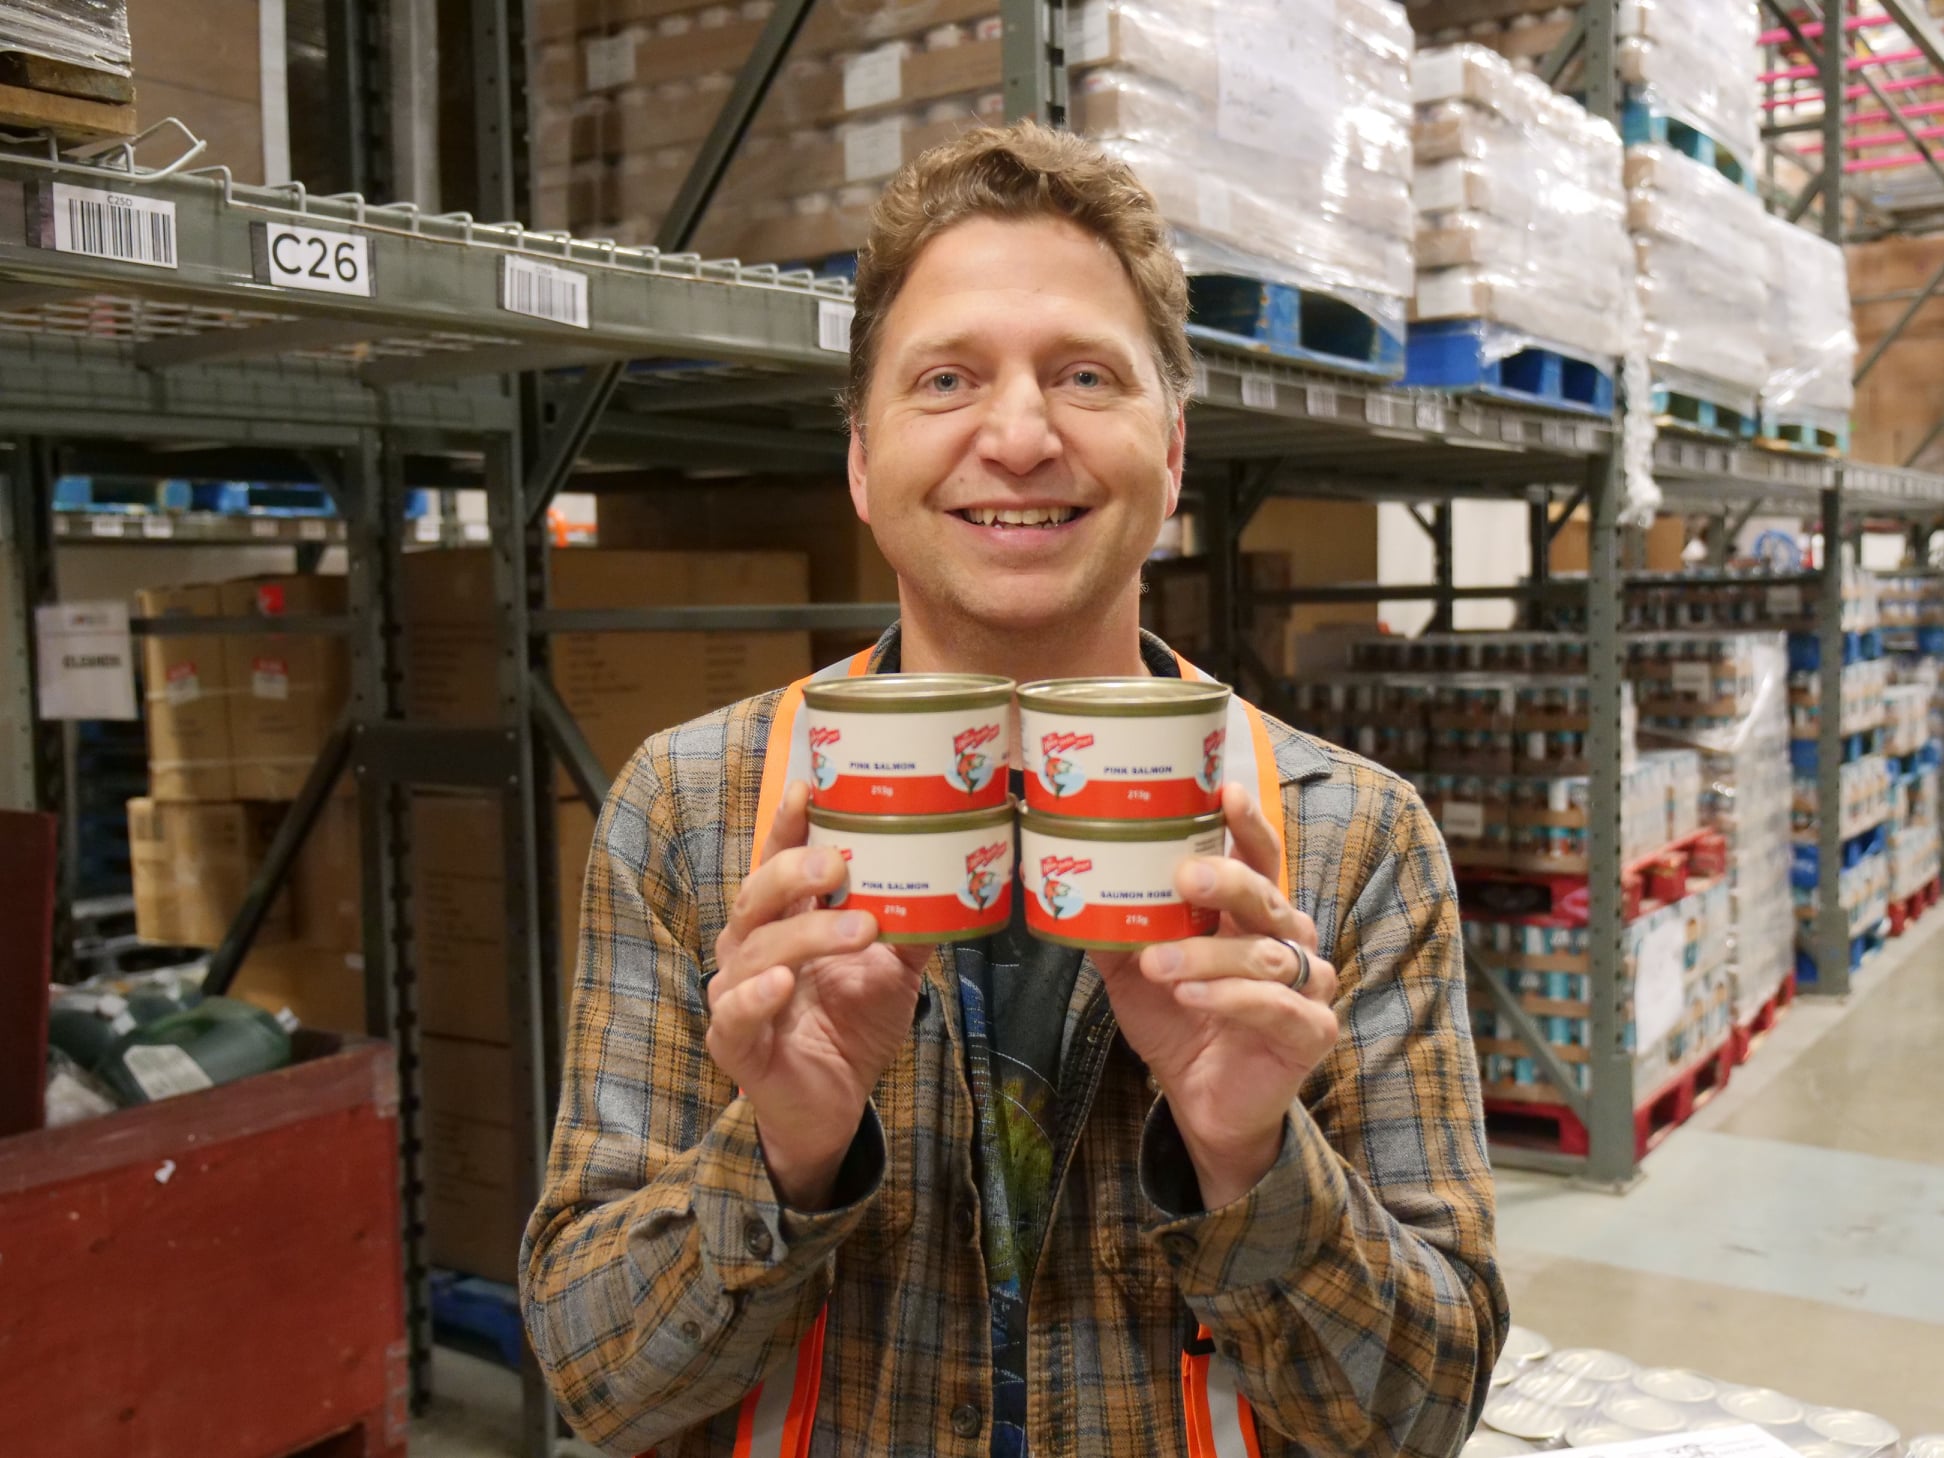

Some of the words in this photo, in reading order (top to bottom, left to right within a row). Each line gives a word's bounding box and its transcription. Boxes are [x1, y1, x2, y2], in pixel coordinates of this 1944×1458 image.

[106, 194, 133, 207] C25D
[272, 233, 358, 282] C26
[849, 762, 870, 770] PINK
[874, 762, 916, 770] SALMON
[1104, 766, 1127, 775] PINK
[1131, 765, 1173, 775] SALMON
[870, 784, 894, 798] 213g
[1127, 789, 1151, 801] 213g
[862, 882, 883, 890] PINK
[887, 882, 929, 890] SALMON
[1100, 890, 1144, 899] SAUMON
[1125, 914, 1150, 927] 213g
